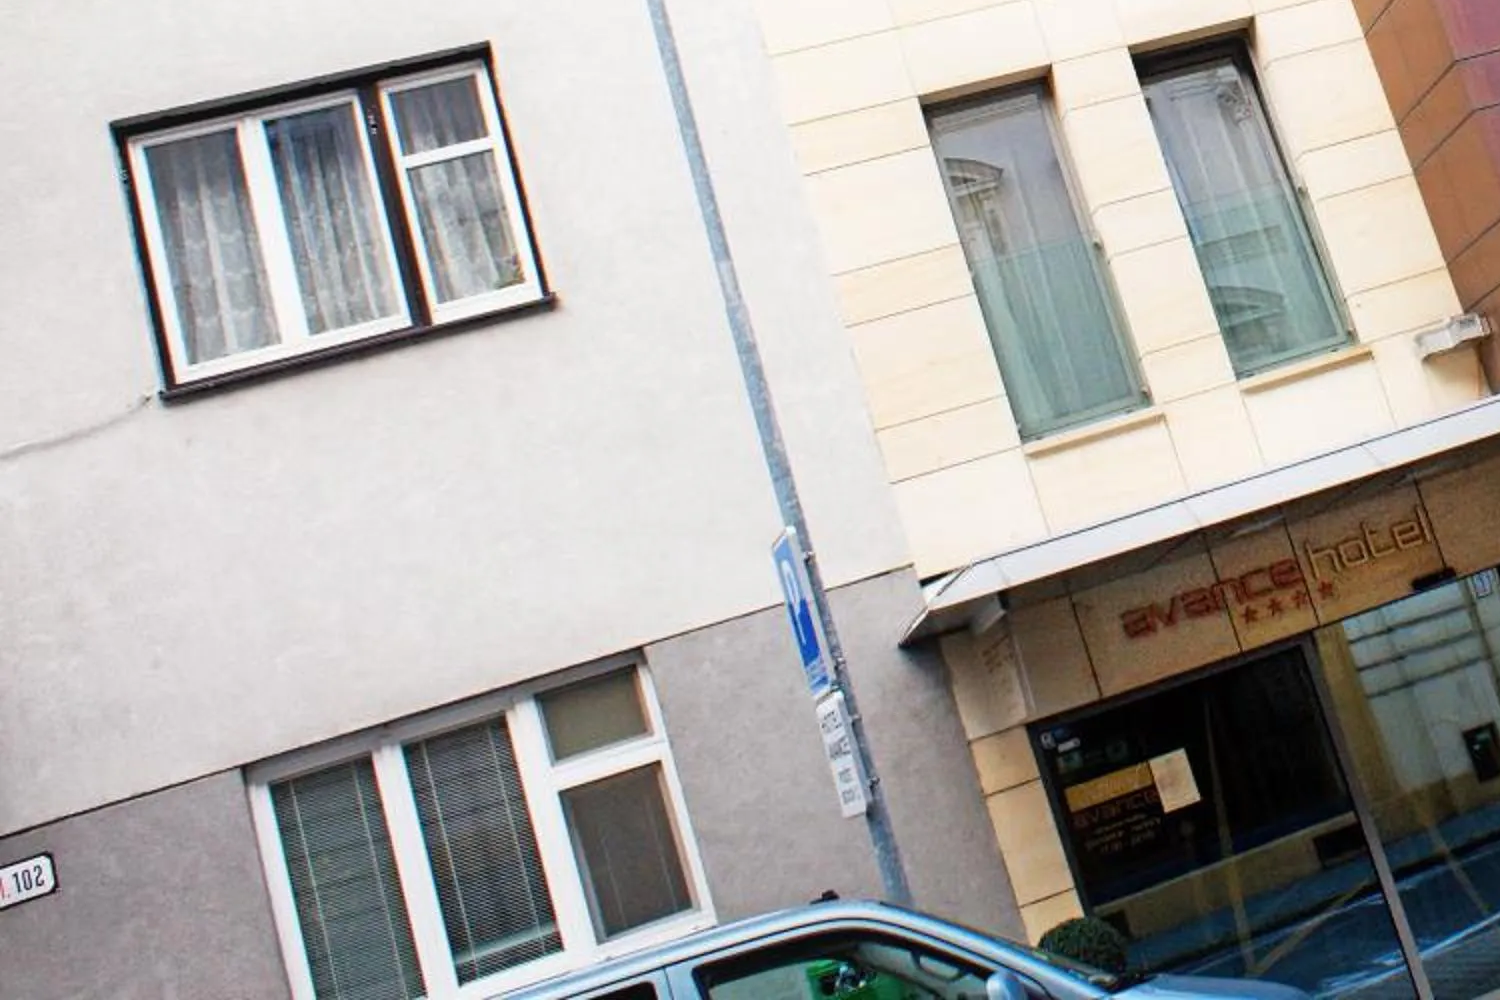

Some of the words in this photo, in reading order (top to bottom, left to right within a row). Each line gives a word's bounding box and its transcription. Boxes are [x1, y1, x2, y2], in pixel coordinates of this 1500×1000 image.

[1120, 556, 1304, 640] avance
[1304, 503, 1434, 580] hotel
[12, 864, 45, 893] 102
